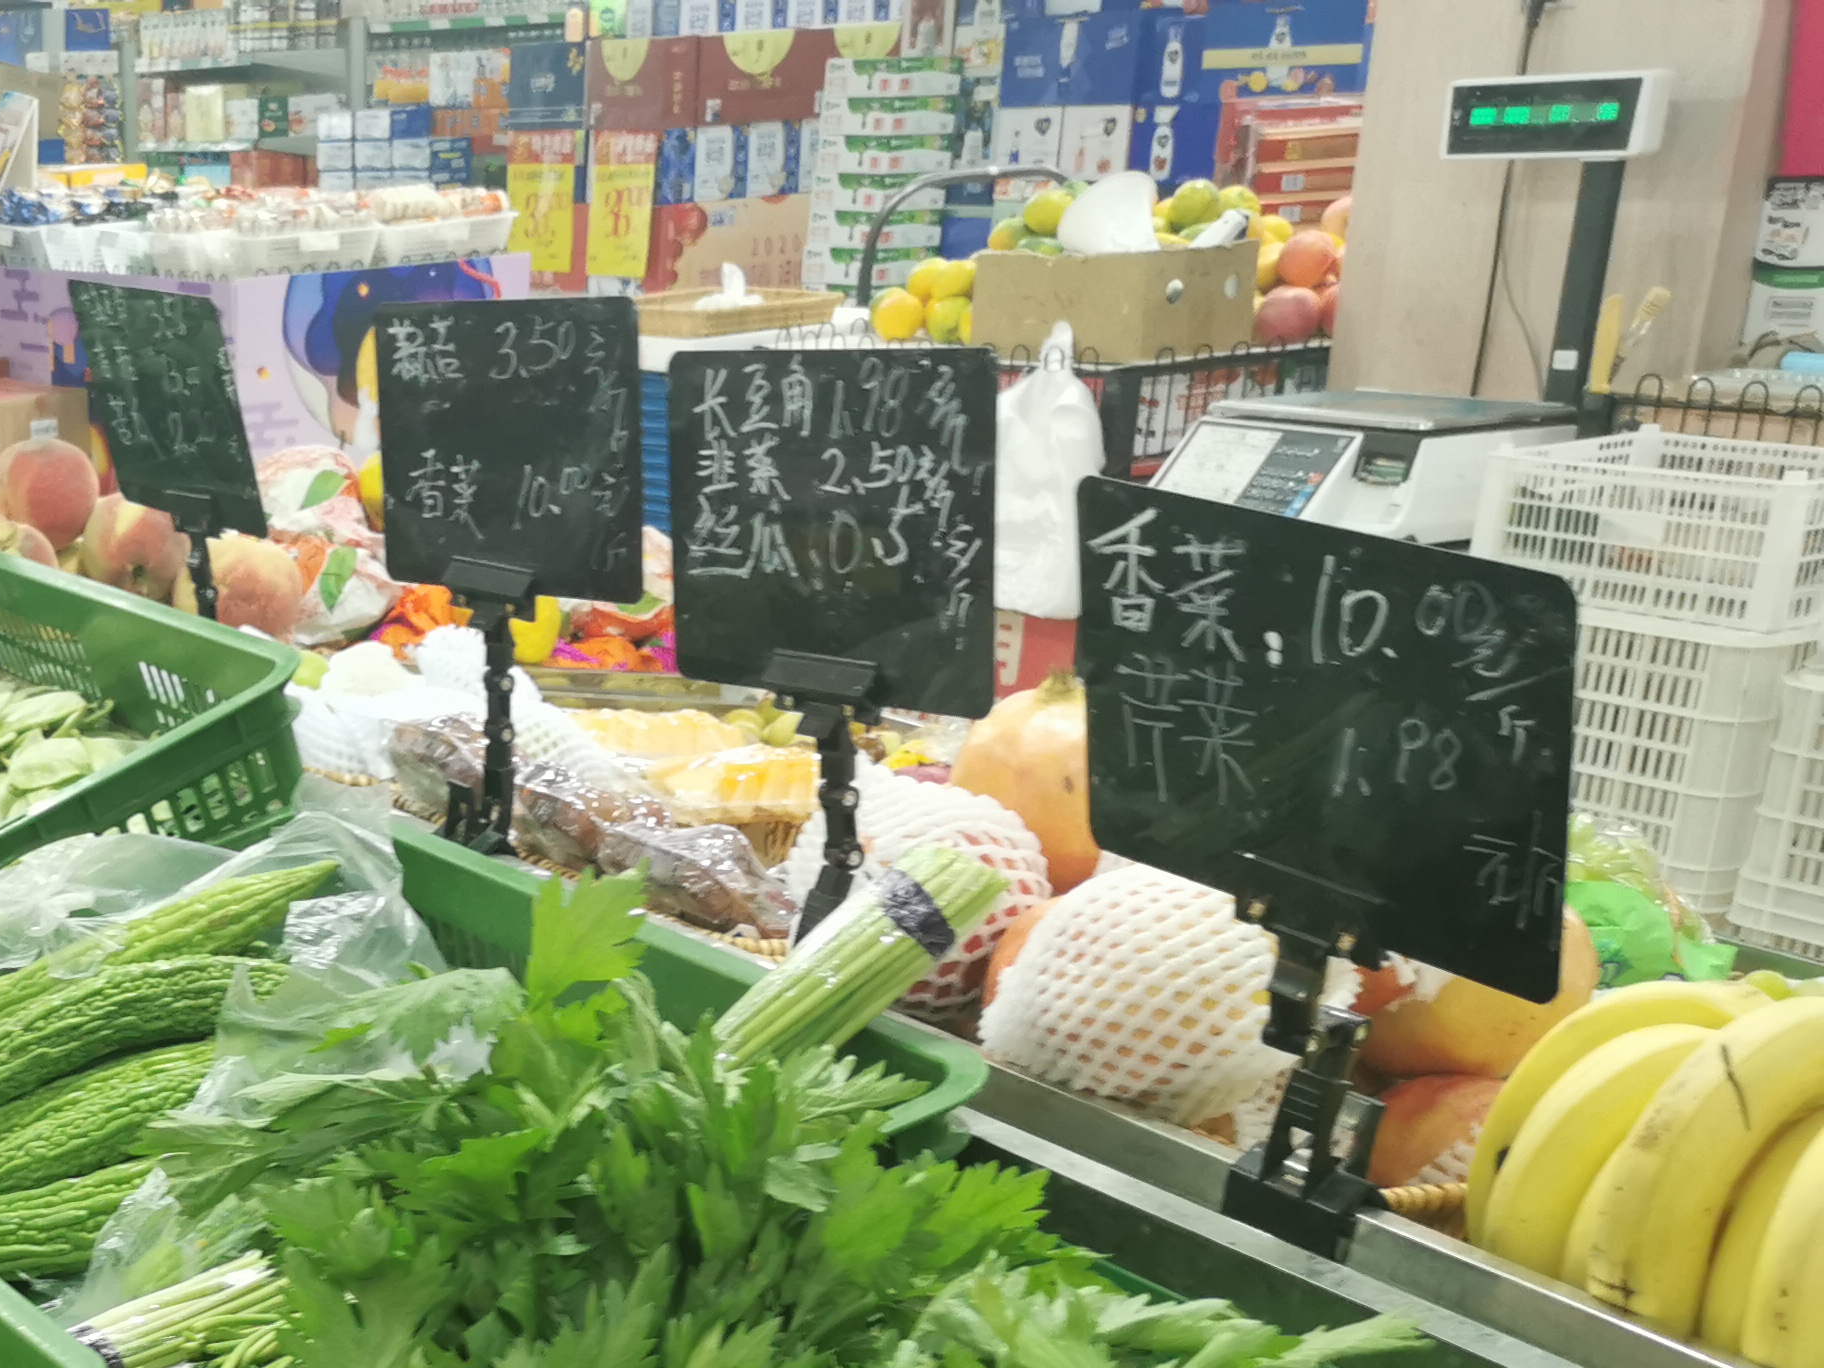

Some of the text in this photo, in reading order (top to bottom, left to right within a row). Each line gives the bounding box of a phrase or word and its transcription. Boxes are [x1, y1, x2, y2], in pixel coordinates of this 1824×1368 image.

[489, 315, 575, 380] 3.50
[693, 353, 814, 438] 长豆角
[828, 355, 911, 438] 1.98
[404, 448, 485, 540] 香菜
[814, 440, 914, 496] 2.50
